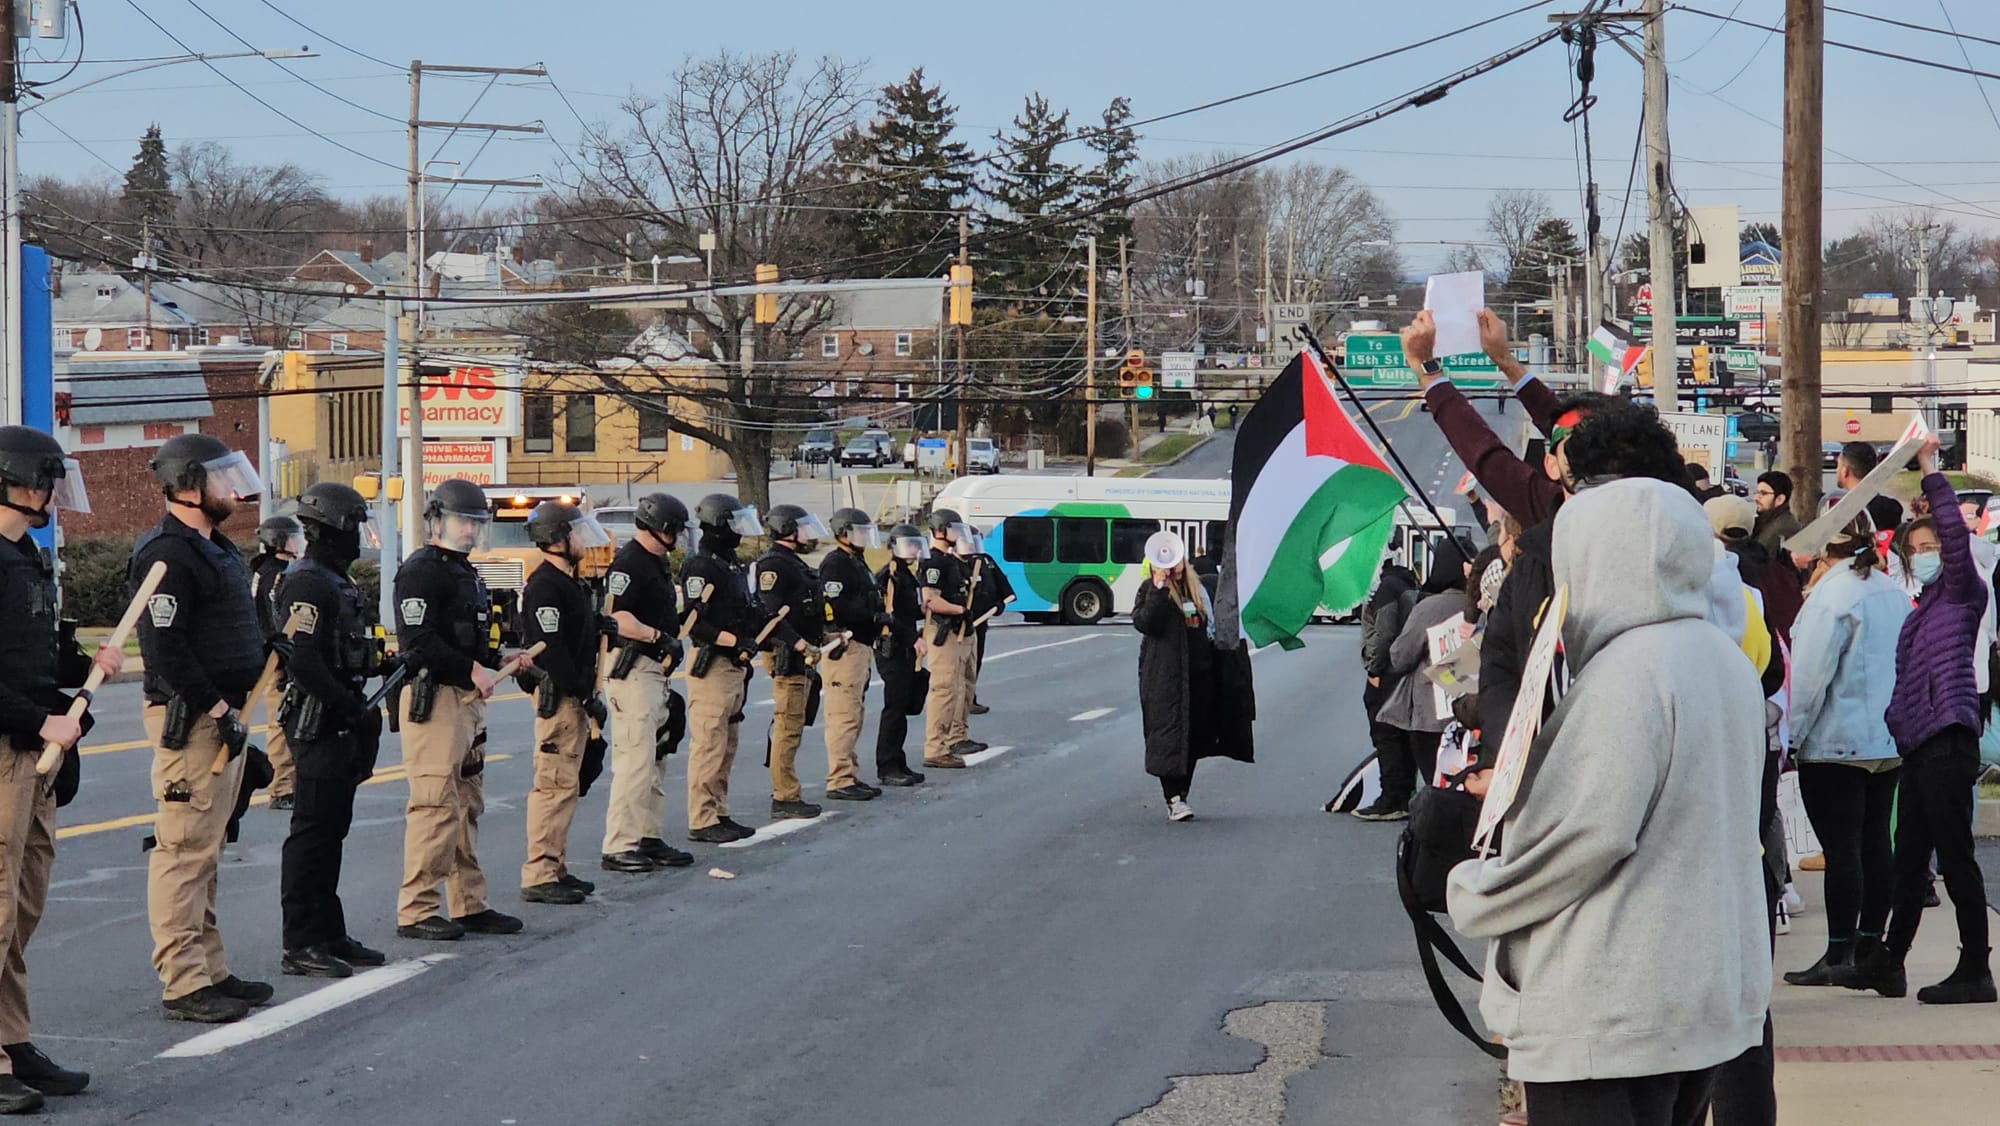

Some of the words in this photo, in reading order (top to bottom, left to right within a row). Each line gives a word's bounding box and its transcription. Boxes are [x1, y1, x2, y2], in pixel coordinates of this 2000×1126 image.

[1279, 307, 1304, 318] END
[1368, 341, 1383, 350] To
[1351, 355, 1378, 365] 15th
[1384, 354, 1399, 365] St
[1449, 355, 1491, 366] Street
[399, 406, 504, 426] parmacy
[1692, 423, 1720, 435] LANE
[422, 444, 490, 453] RIVE-THRU
